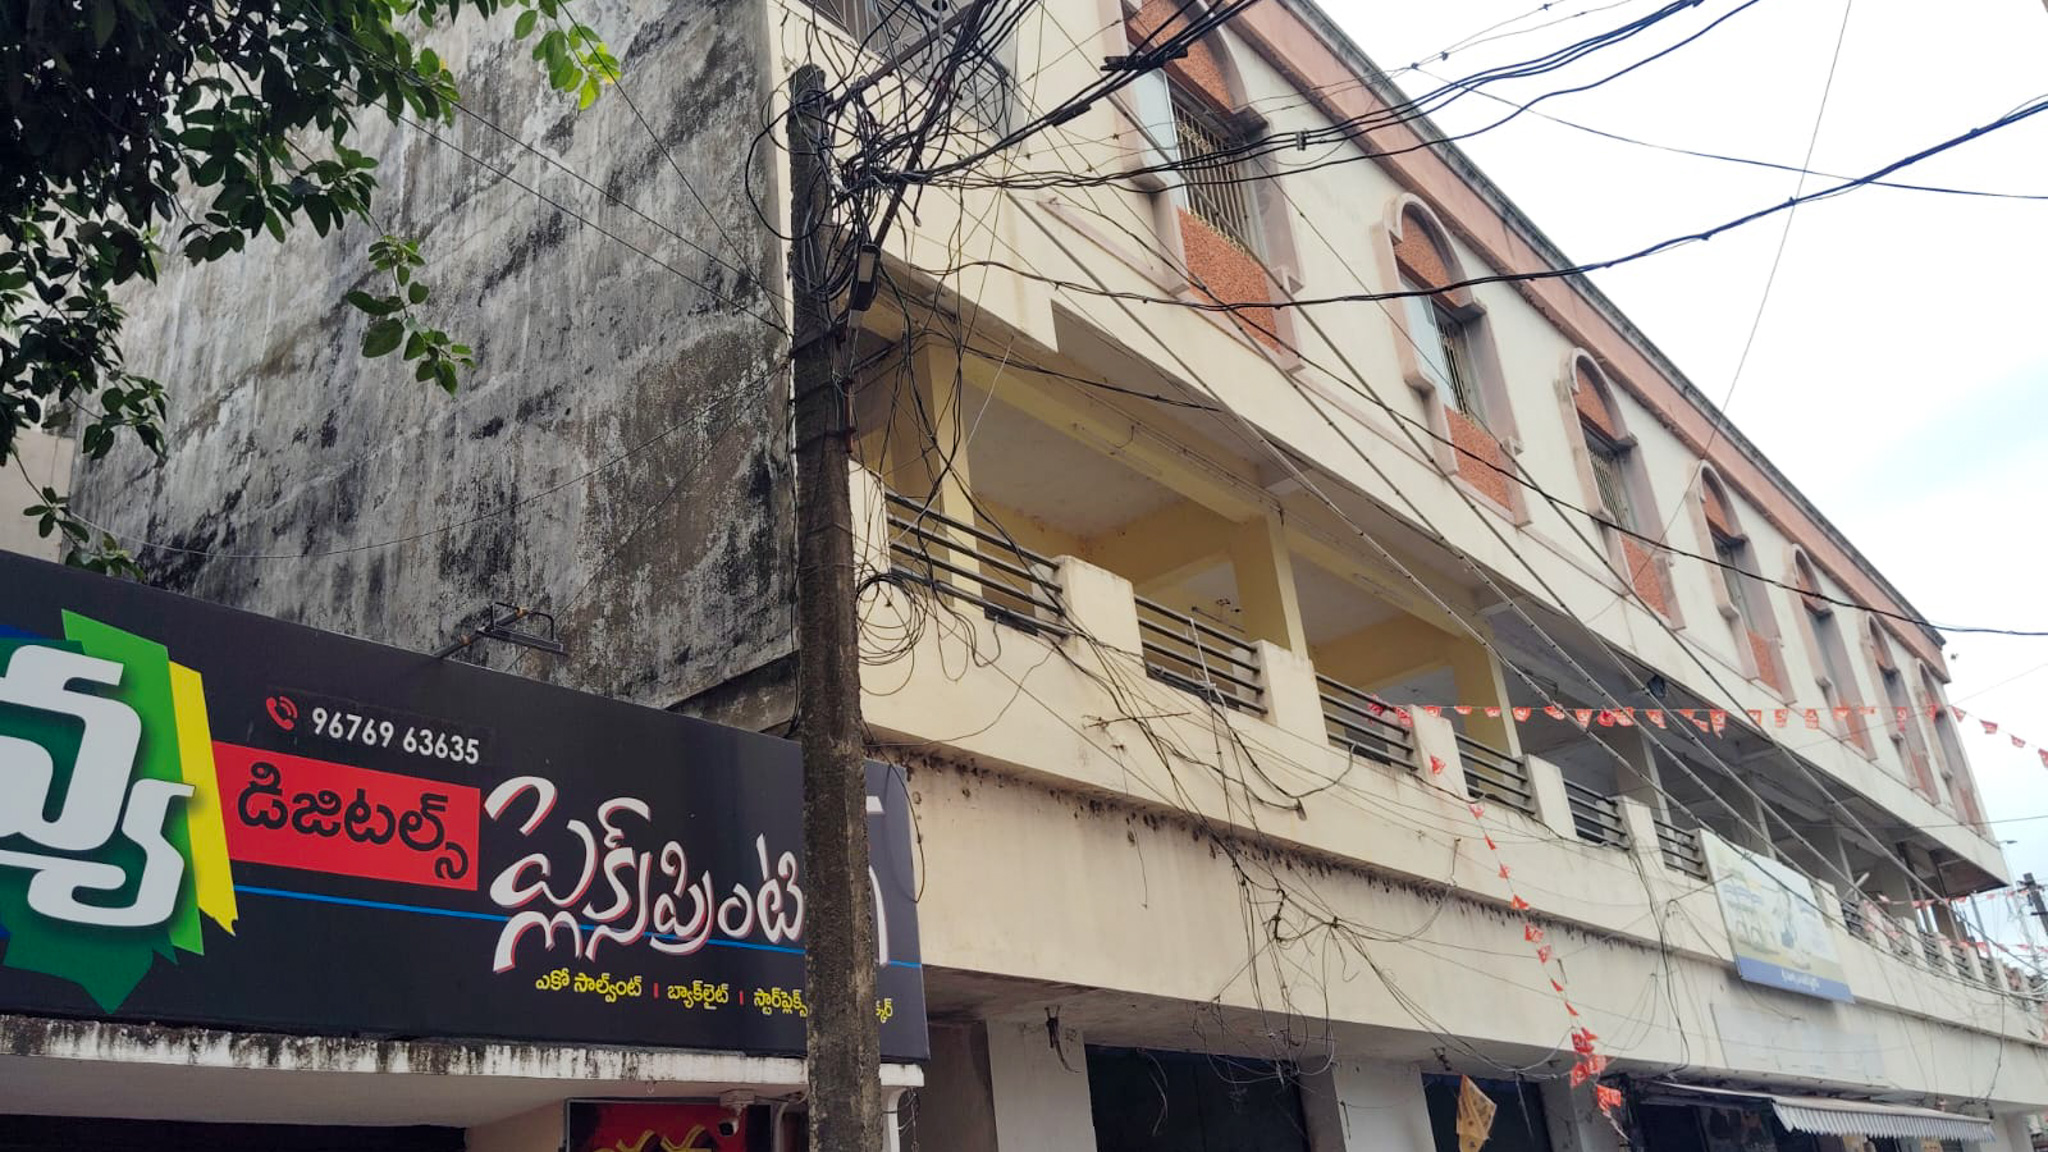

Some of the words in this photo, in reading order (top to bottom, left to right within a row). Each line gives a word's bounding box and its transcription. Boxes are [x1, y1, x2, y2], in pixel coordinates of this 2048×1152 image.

[311, 707, 395, 748] 96769
[402, 727, 481, 764] 63635
[238, 762, 469, 880] డిజిటల్స్
